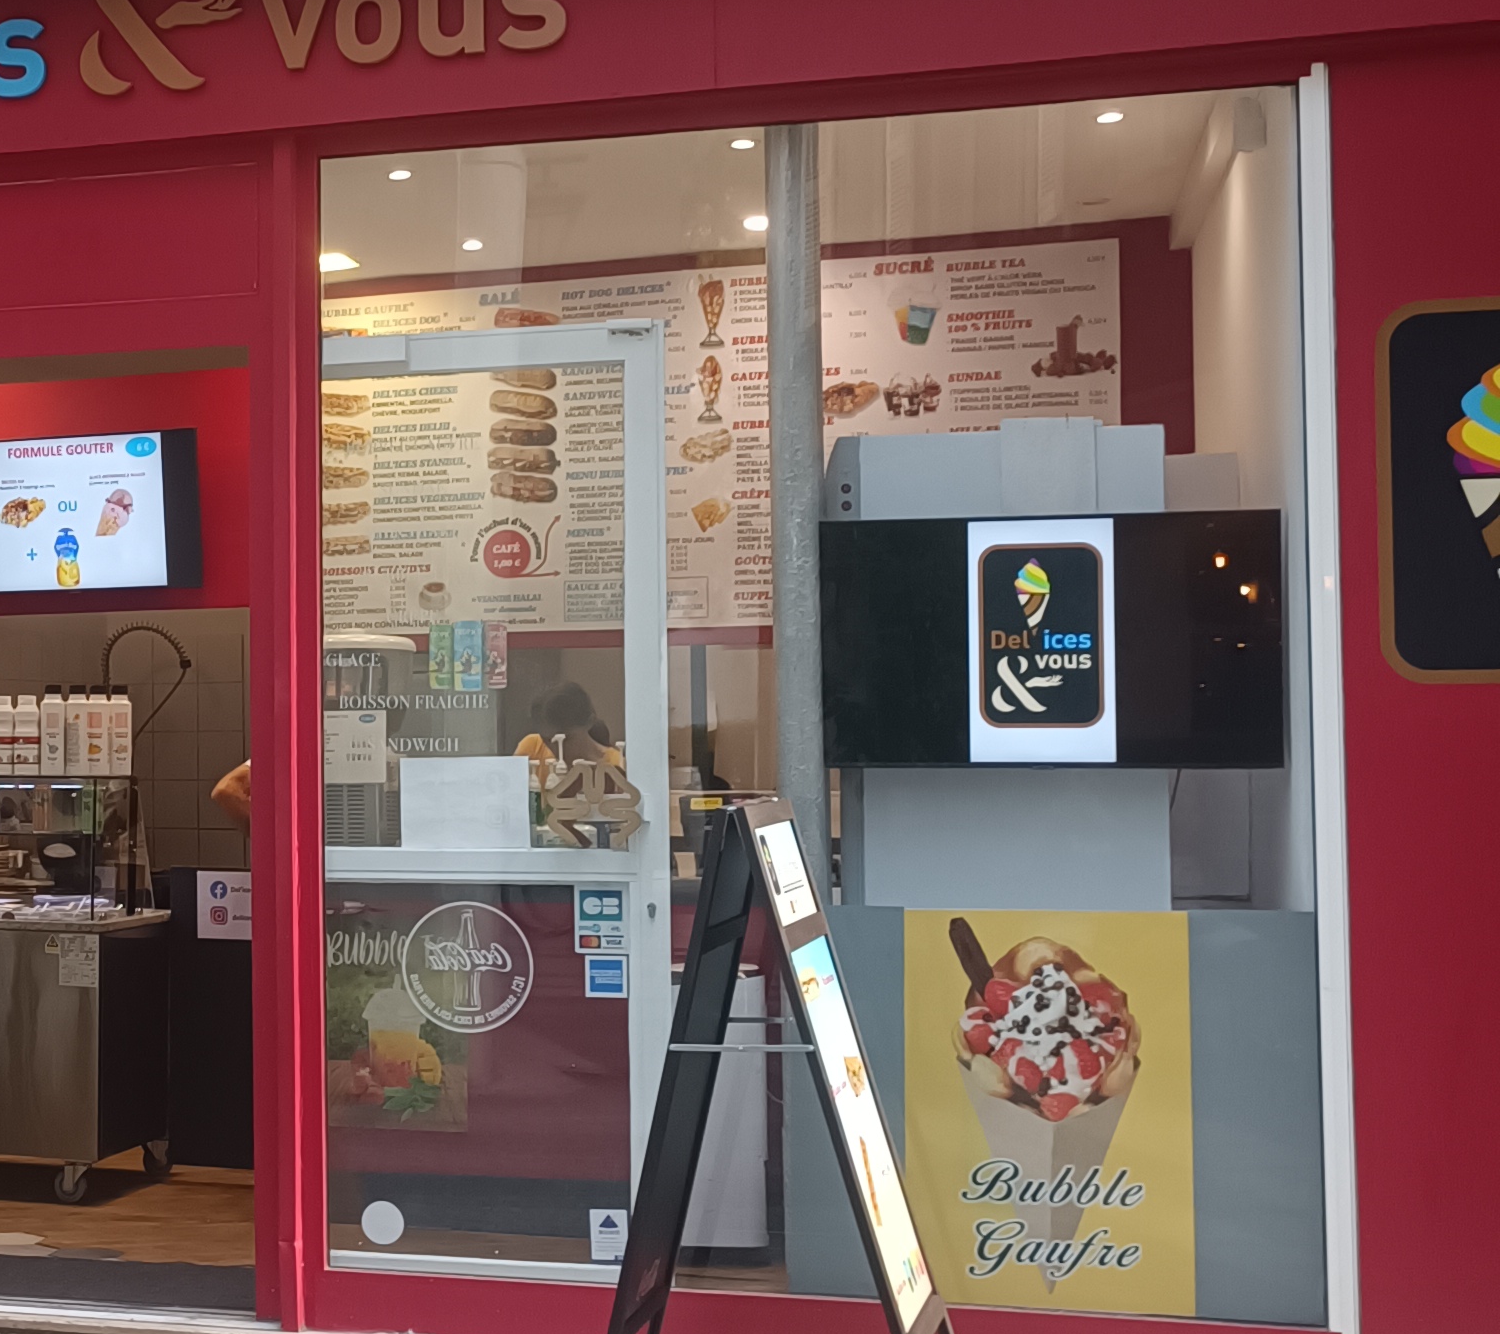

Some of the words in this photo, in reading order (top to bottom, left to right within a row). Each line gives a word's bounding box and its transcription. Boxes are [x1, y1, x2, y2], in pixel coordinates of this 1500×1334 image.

[873, 256, 935, 276] SUCRÉ
[946, 259, 997, 273] BUBBLE
[1000, 257, 1026, 268] TEA
[478, 288, 521, 306] SALÉ
[946, 309, 1015, 323] SMOOTHIE
[947, 324, 968, 333] 100
[984, 319, 1033, 331] FRUITS
[561, 362, 623, 376] SANDWIC
[948, 370, 1002, 383] SUNDAE
[563, 389, 622, 401] SANDWIC
[7, 444, 63, 459] FORMULE
[65, 442, 114, 457] GOUTER
[57, 500, 78, 512] OU
[492, 541, 521, 554] CAFÉ
[733, 591, 772, 601] SUPPL
[325, 652, 381, 667] GLACE
[1034, 653, 1092, 669] vous
[339, 695, 411, 709] BOISSON
[415, 694, 489, 709] FRAICHE
[960, 1158, 1145, 1208] Bubble
[967, 1219, 1142, 1279] Gaufre
